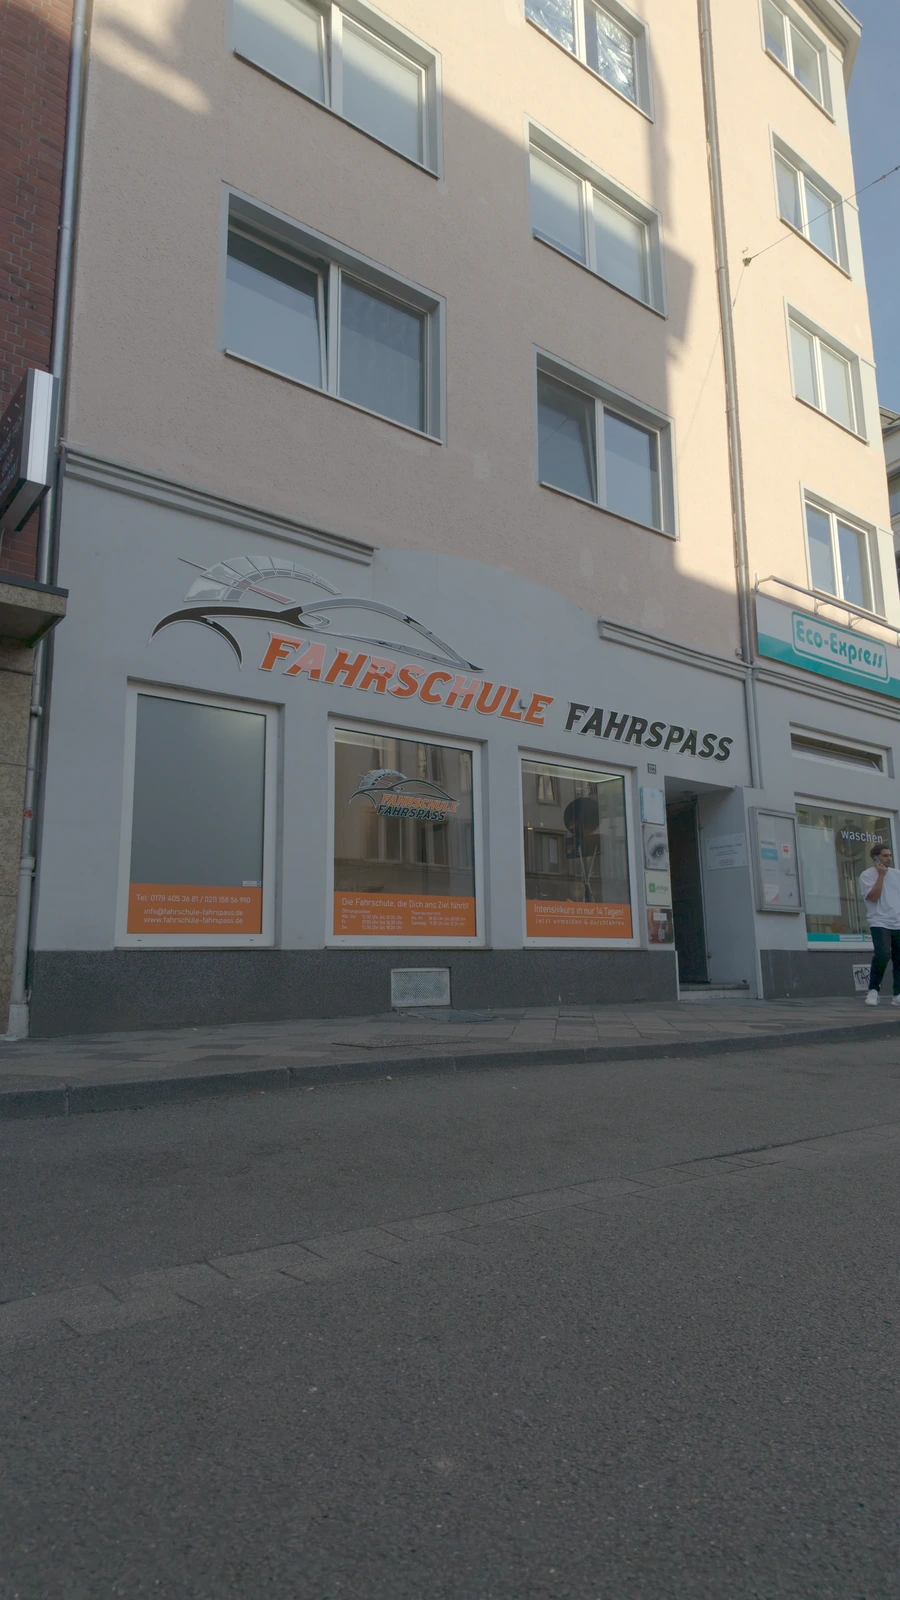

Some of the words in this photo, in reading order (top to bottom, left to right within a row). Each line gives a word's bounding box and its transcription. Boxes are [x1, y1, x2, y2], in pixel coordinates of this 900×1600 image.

[796, 620, 883, 668] Eco-Express
[258, 631, 555, 726] FAHRSCHULE
[564, 701, 734, 763] FAHRSPASS
[381, 793, 460, 812] FAHRSCHULE
[377, 804, 446, 821] FAHRSPASS
[841, 830, 883, 844] waschen
[151, 894, 165, 902] 0178
[341, 897, 353, 906] Die
[355, 898, 396, 908] Fahrschule,
[397, 900, 407, 908] die
[409, 900, 423, 908] Dich
[438, 901, 449, 909] Ziel
[144, 908, 243, 917] info@fahrschule-fahrspass.de
[534, 904, 574, 914] Intensivkurs
[596, 907, 603, 915] 14
[604, 907, 624, 917] Tagen!
[144, 916, 243, 925] www.fahrschule-fahrspass.de
